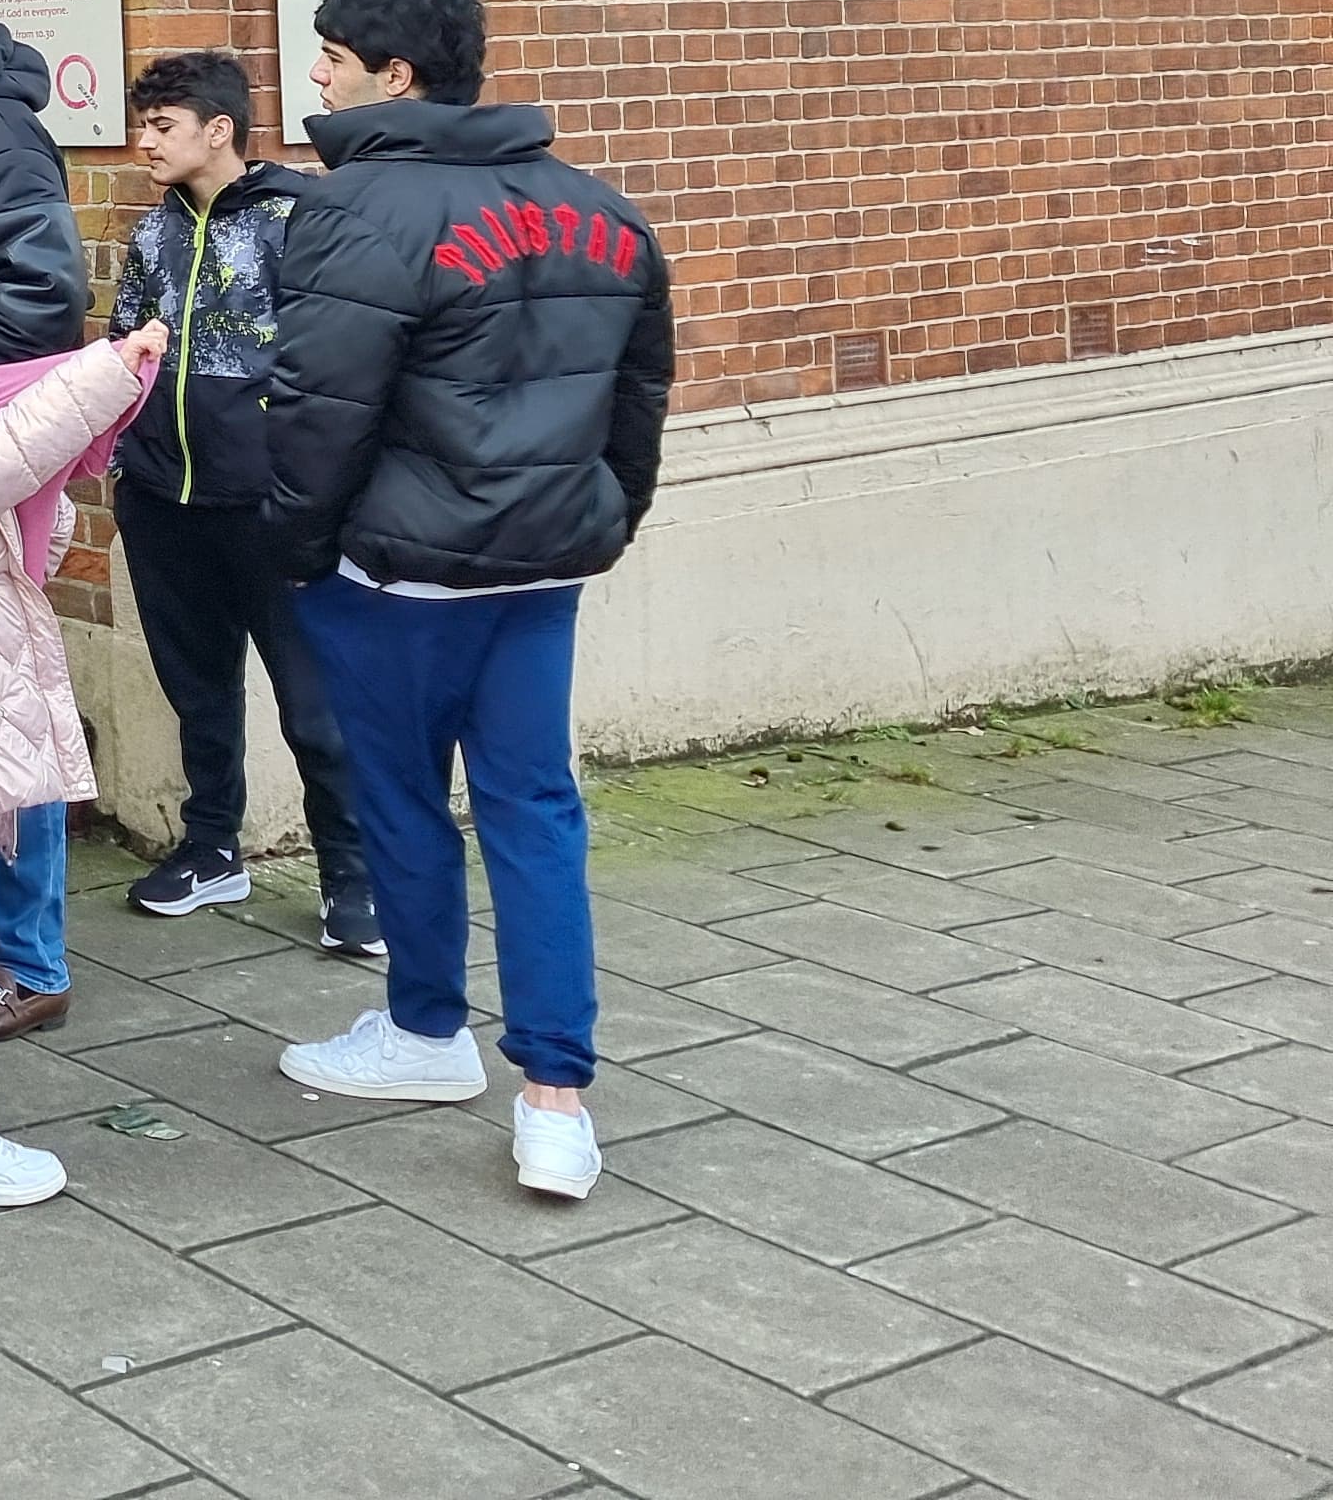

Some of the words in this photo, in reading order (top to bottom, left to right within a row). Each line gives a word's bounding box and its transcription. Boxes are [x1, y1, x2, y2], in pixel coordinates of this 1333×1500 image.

[7, 8, 21, 18] God
[23, 8, 30, 17] in
[31, 6, 69, 18] everyone.
[15, 29, 34, 38] from
[35, 29, 54, 40] 10.30
